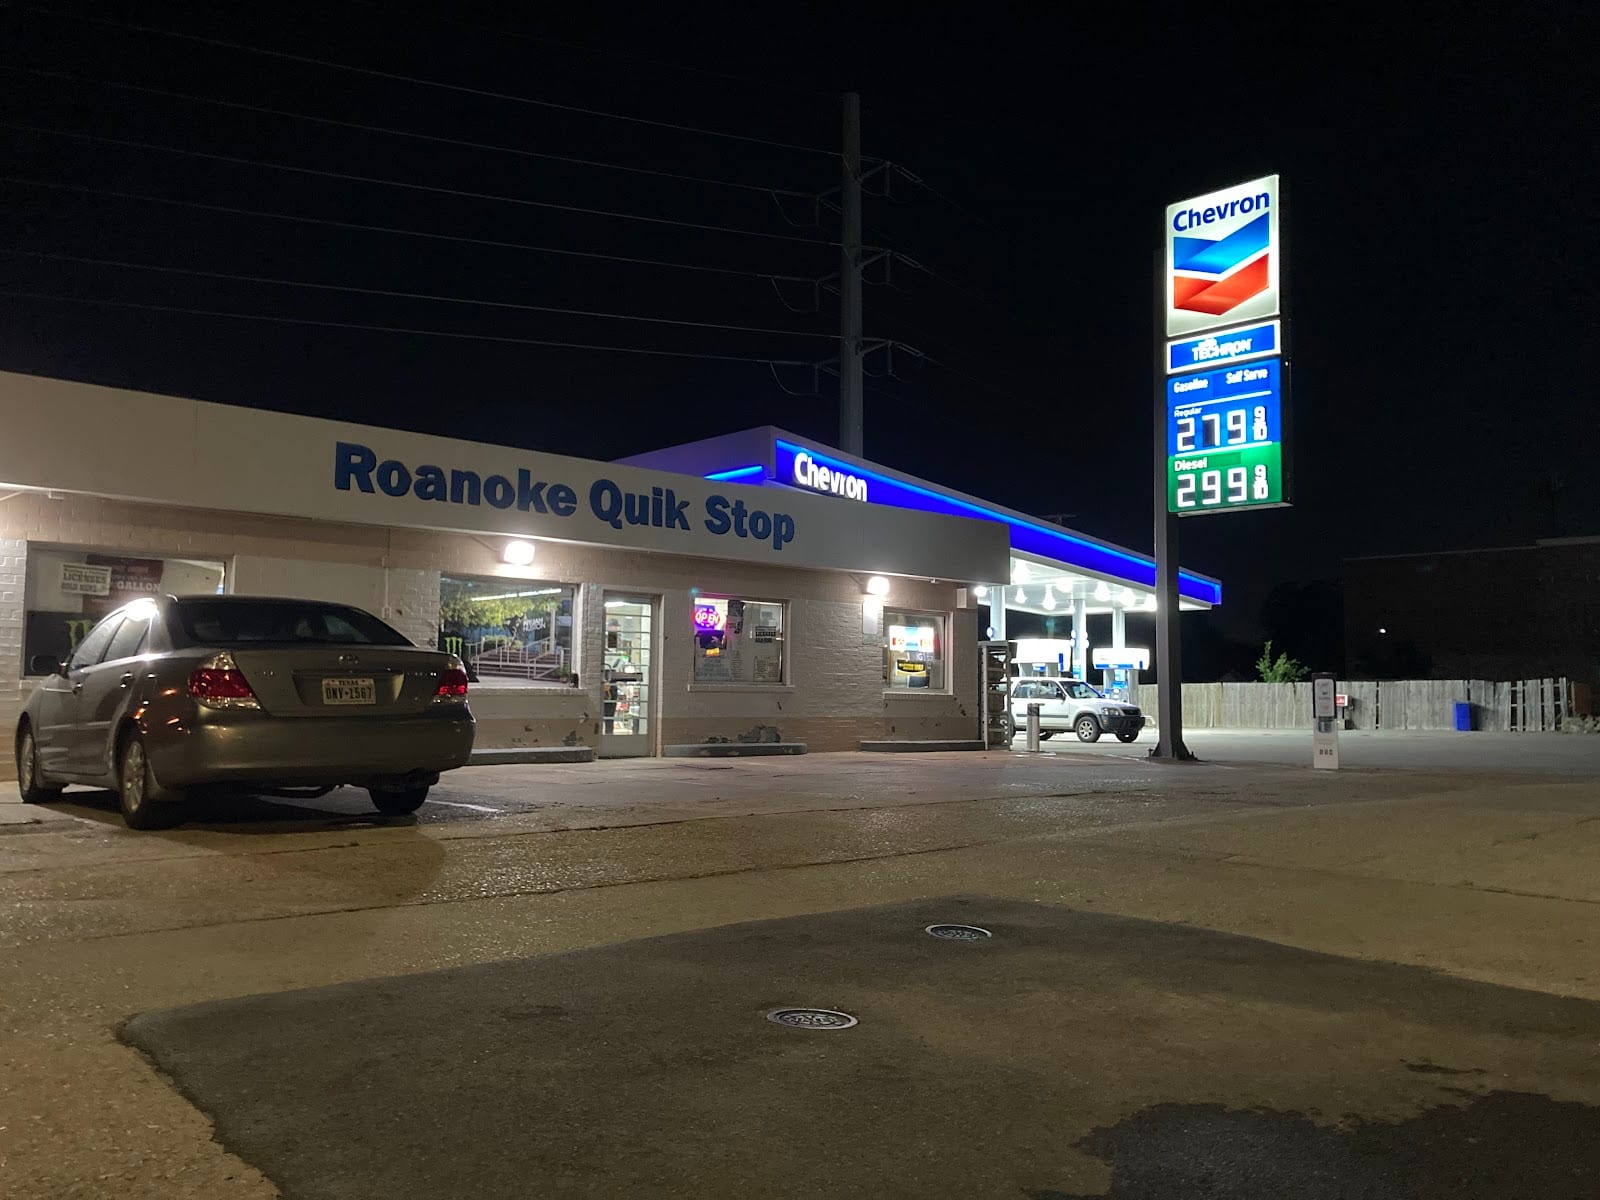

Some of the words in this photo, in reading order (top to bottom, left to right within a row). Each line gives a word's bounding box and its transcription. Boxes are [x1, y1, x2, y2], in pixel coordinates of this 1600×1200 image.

[1173, 192, 1269, 232] Chevron
[1174, 378, 1208, 393] Gasoline
[1225, 370, 1242, 384] Self
[1243, 369, 1268, 381] Serve
[1174, 407, 1202, 417] Regular
[1174, 457, 1207, 471] Diesel
[794, 452, 867, 502] Chevron
[334, 441, 578, 516] Roanoke
[589, 478, 691, 530] Quik
[704, 495, 795, 550] Stop
[695, 611, 720, 626] OPEN
